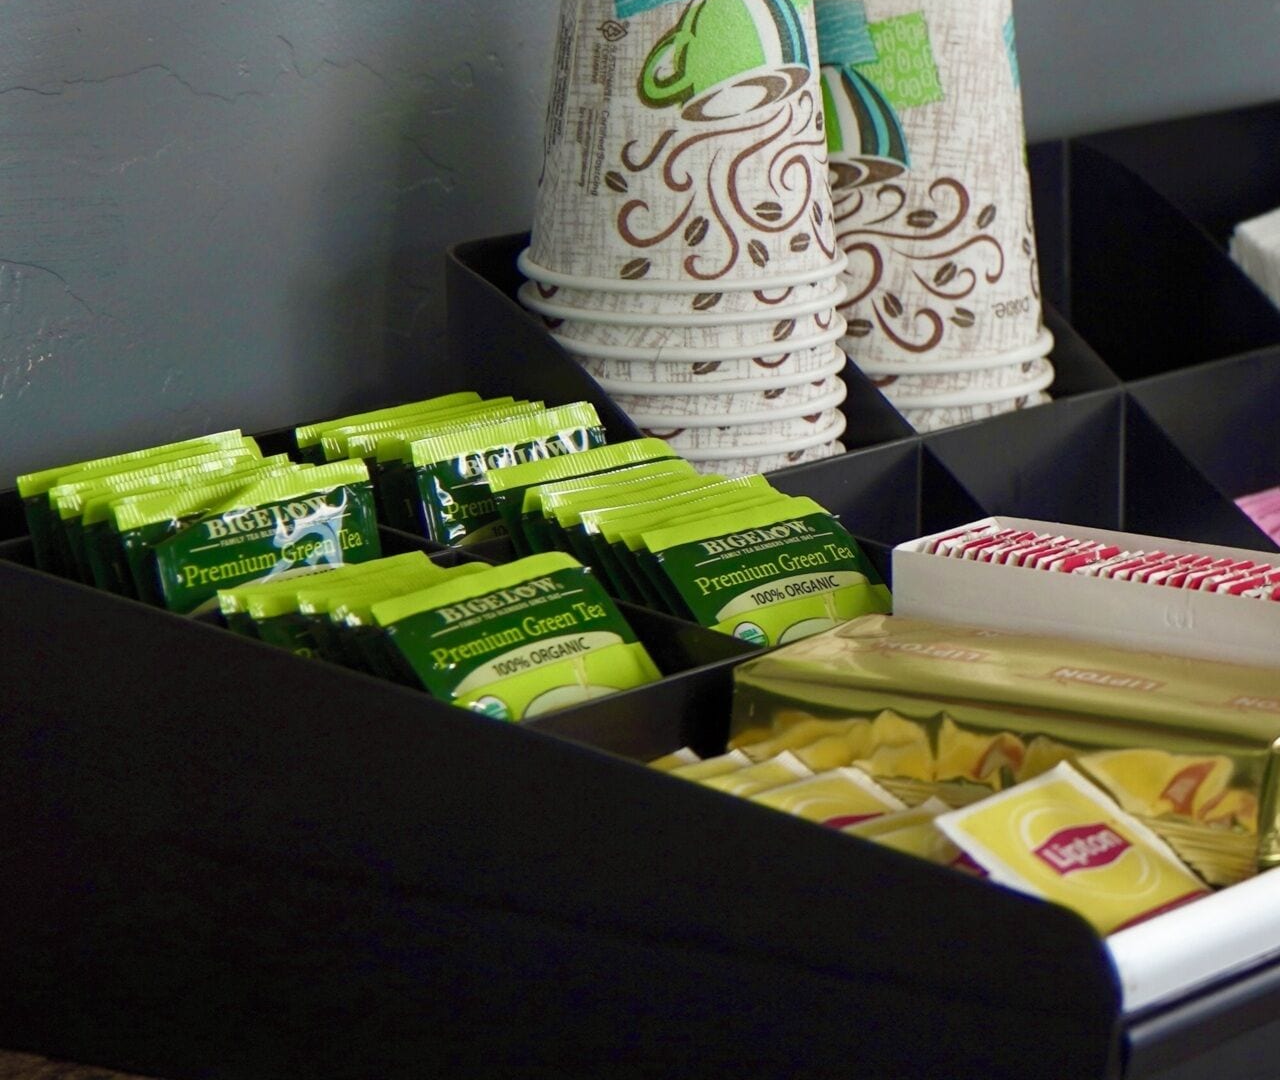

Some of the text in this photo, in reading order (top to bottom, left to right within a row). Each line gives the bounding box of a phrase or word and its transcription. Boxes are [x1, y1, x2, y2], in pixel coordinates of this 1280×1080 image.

[590, 109, 610, 197] Certified Sourcing
[203, 495, 330, 540] BIGELOW
[698, 520, 811, 556] BIGELOW
[182, 552, 277, 588] Premium
[281, 538, 336, 564] Green
[337, 528, 364, 551] Tea
[693, 542, 855, 596] Premium Green Tea
[435, 576, 559, 625] BIGELOW
[751, 575, 840, 606] 100% ORGANIC
[429, 602, 608, 670] Premium Green Tea
[491, 636, 591, 677] 100% ORGANIC
[1054, 666, 1158, 691] LIPTON
[1042, 825, 1125, 871] Lipton
